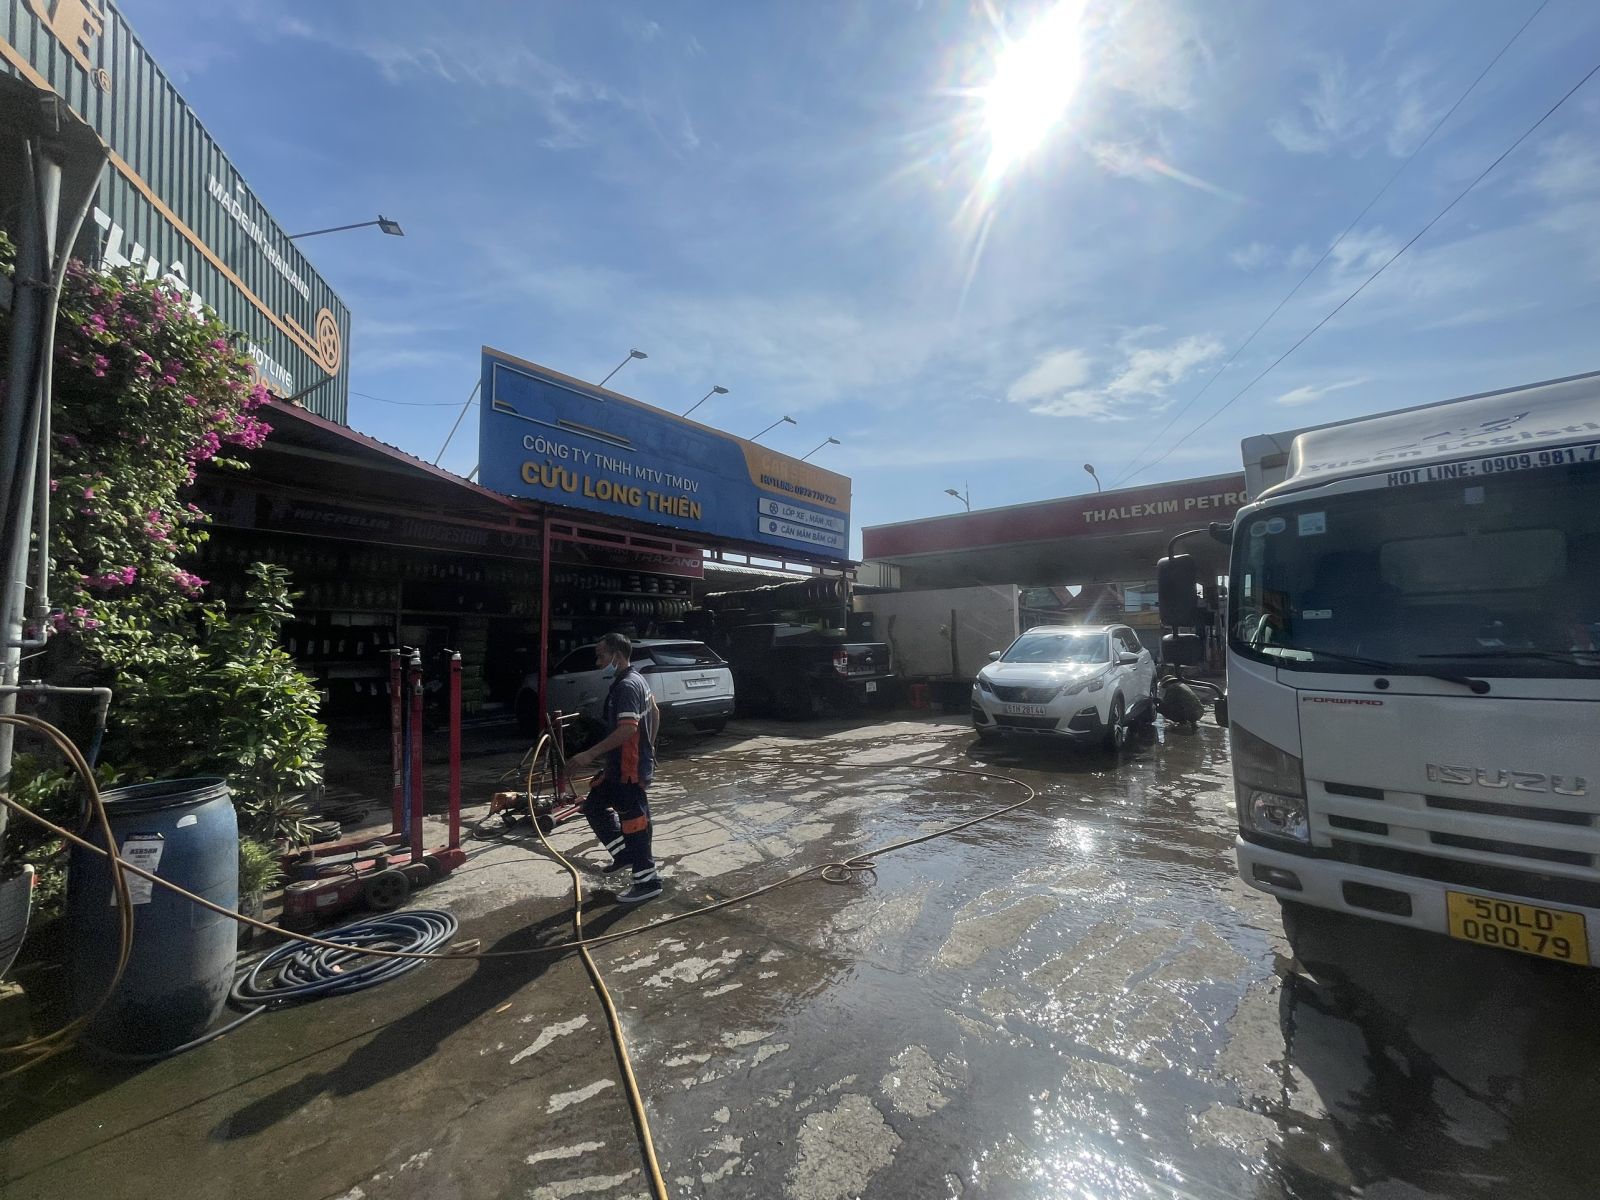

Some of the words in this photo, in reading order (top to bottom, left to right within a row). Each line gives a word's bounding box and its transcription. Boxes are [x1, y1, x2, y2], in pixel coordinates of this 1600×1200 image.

[208, 174, 250, 230] MADE
[248, 221, 263, 245] IN
[262, 238, 310, 303] THAILAND
[523, 434, 568, 459] CÔNG
[571, 447, 591, 464] TY
[594, 453, 632, 477] TNHH
[635, 465, 664, 484] MTV
[1306, 449, 1422, 472] Yusen
[1387, 470, 1421, 487] HOT
[1427, 462, 1475, 481] LINE:
[1481, 445, 1597, 473] 0909.981.7
[521, 459, 578, 493] CỬU
[583, 475, 642, 508] LONG
[646, 489, 702, 521] THIÊN
[1082, 499, 1179, 523] THALEXIM
[634, 552, 701, 568] TRAZANO
[1303, 696, 1384, 706] FORWARD
[1426, 763, 1586, 797] ISUZU
[1474, 898, 1553, 931] 50LD
[1463, 919, 1571, 959] 080.79
